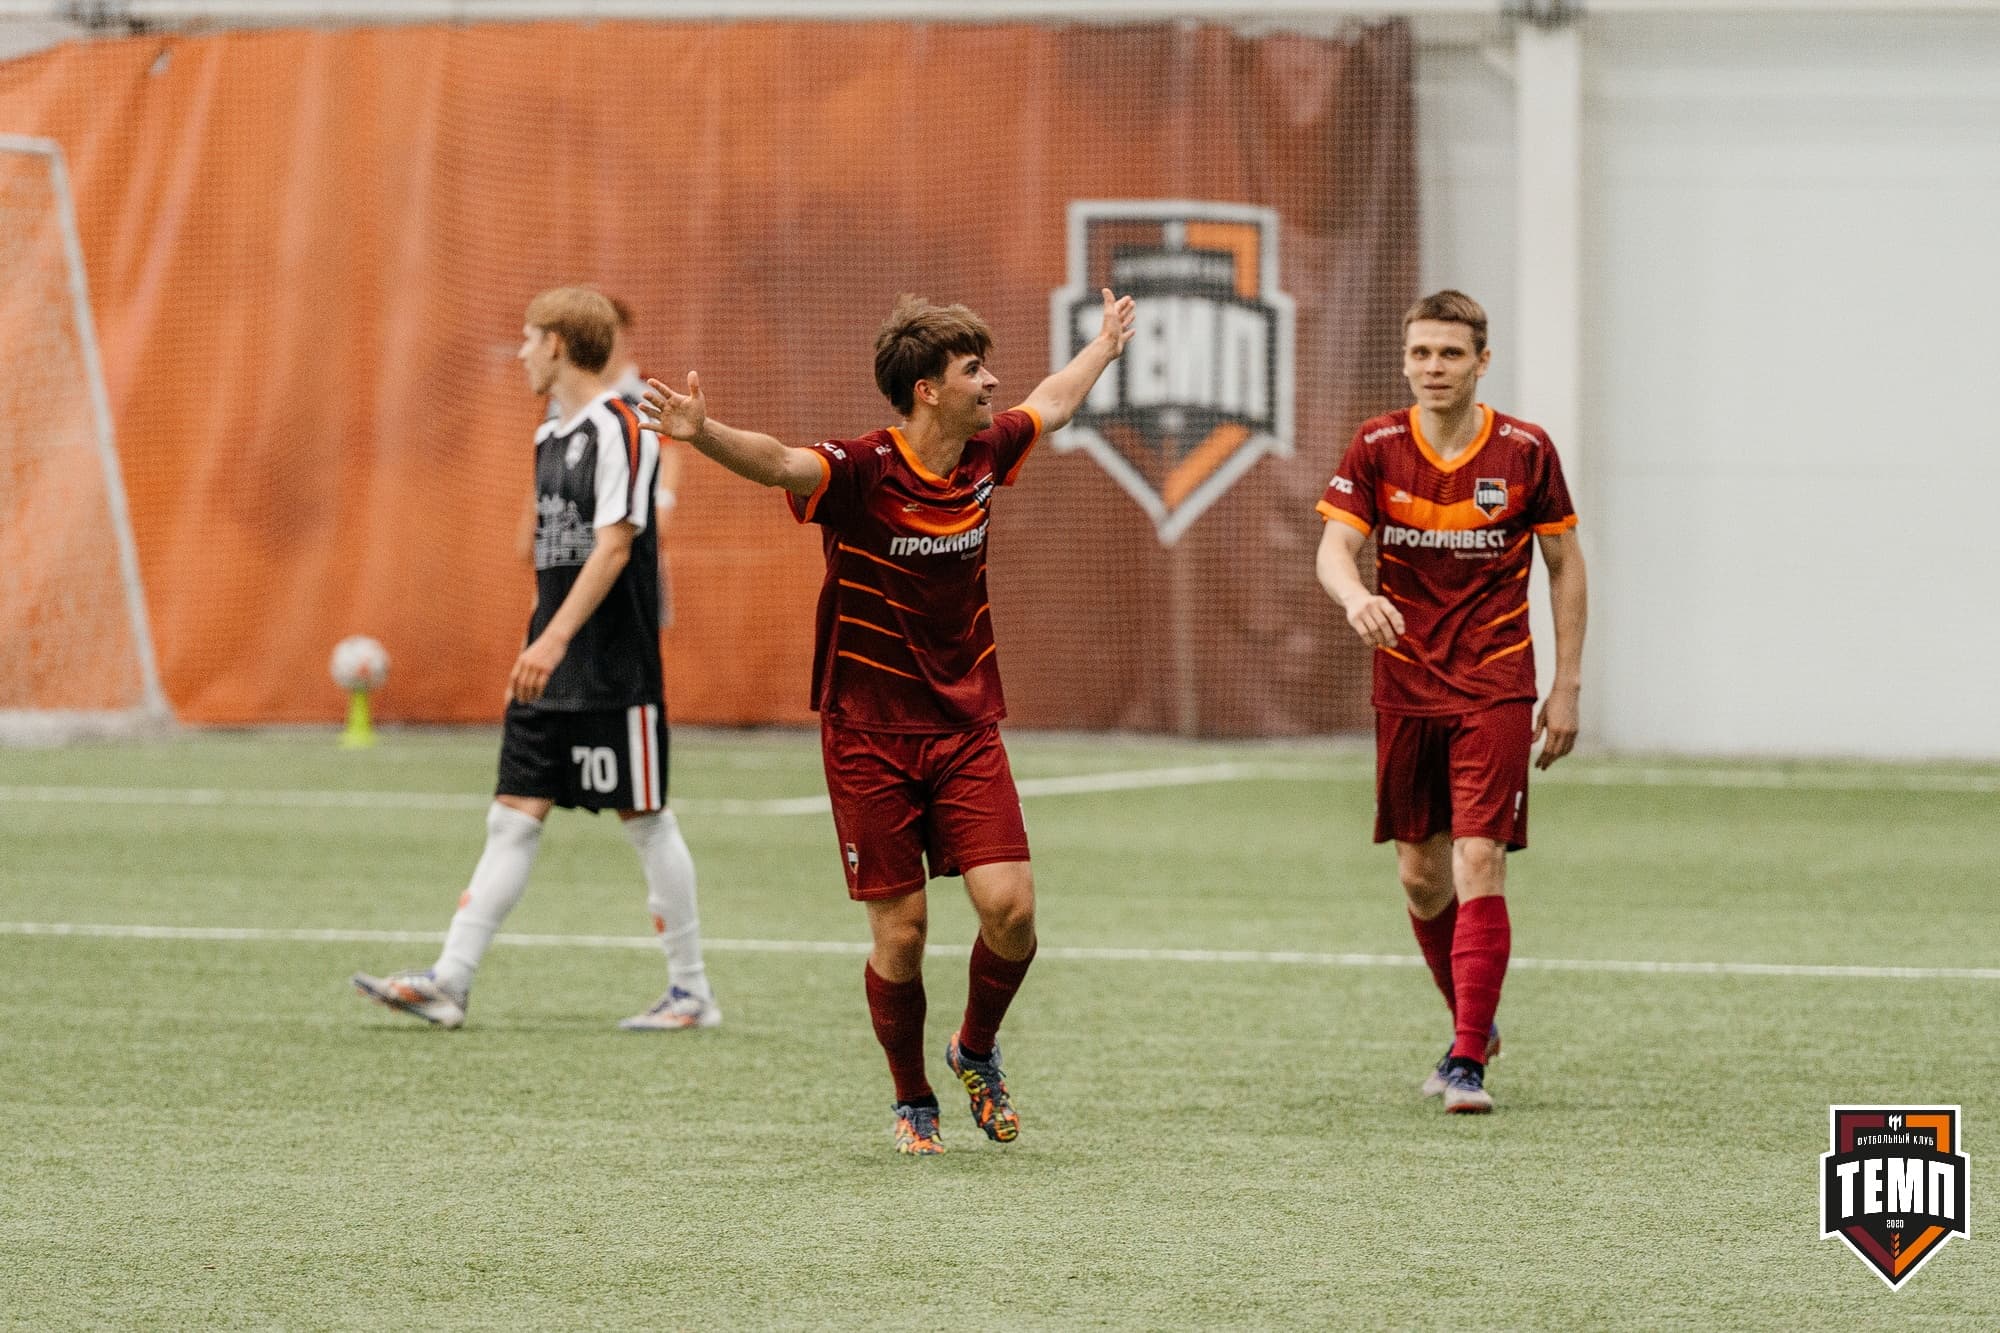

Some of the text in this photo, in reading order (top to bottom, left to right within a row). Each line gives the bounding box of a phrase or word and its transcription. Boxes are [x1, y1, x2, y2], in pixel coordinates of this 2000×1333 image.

[889, 519, 989, 556] ПРОДИНВЕ
[1383, 525, 1506, 549] ПРОДИНВЕСТ
[571, 746, 618, 793] 70
